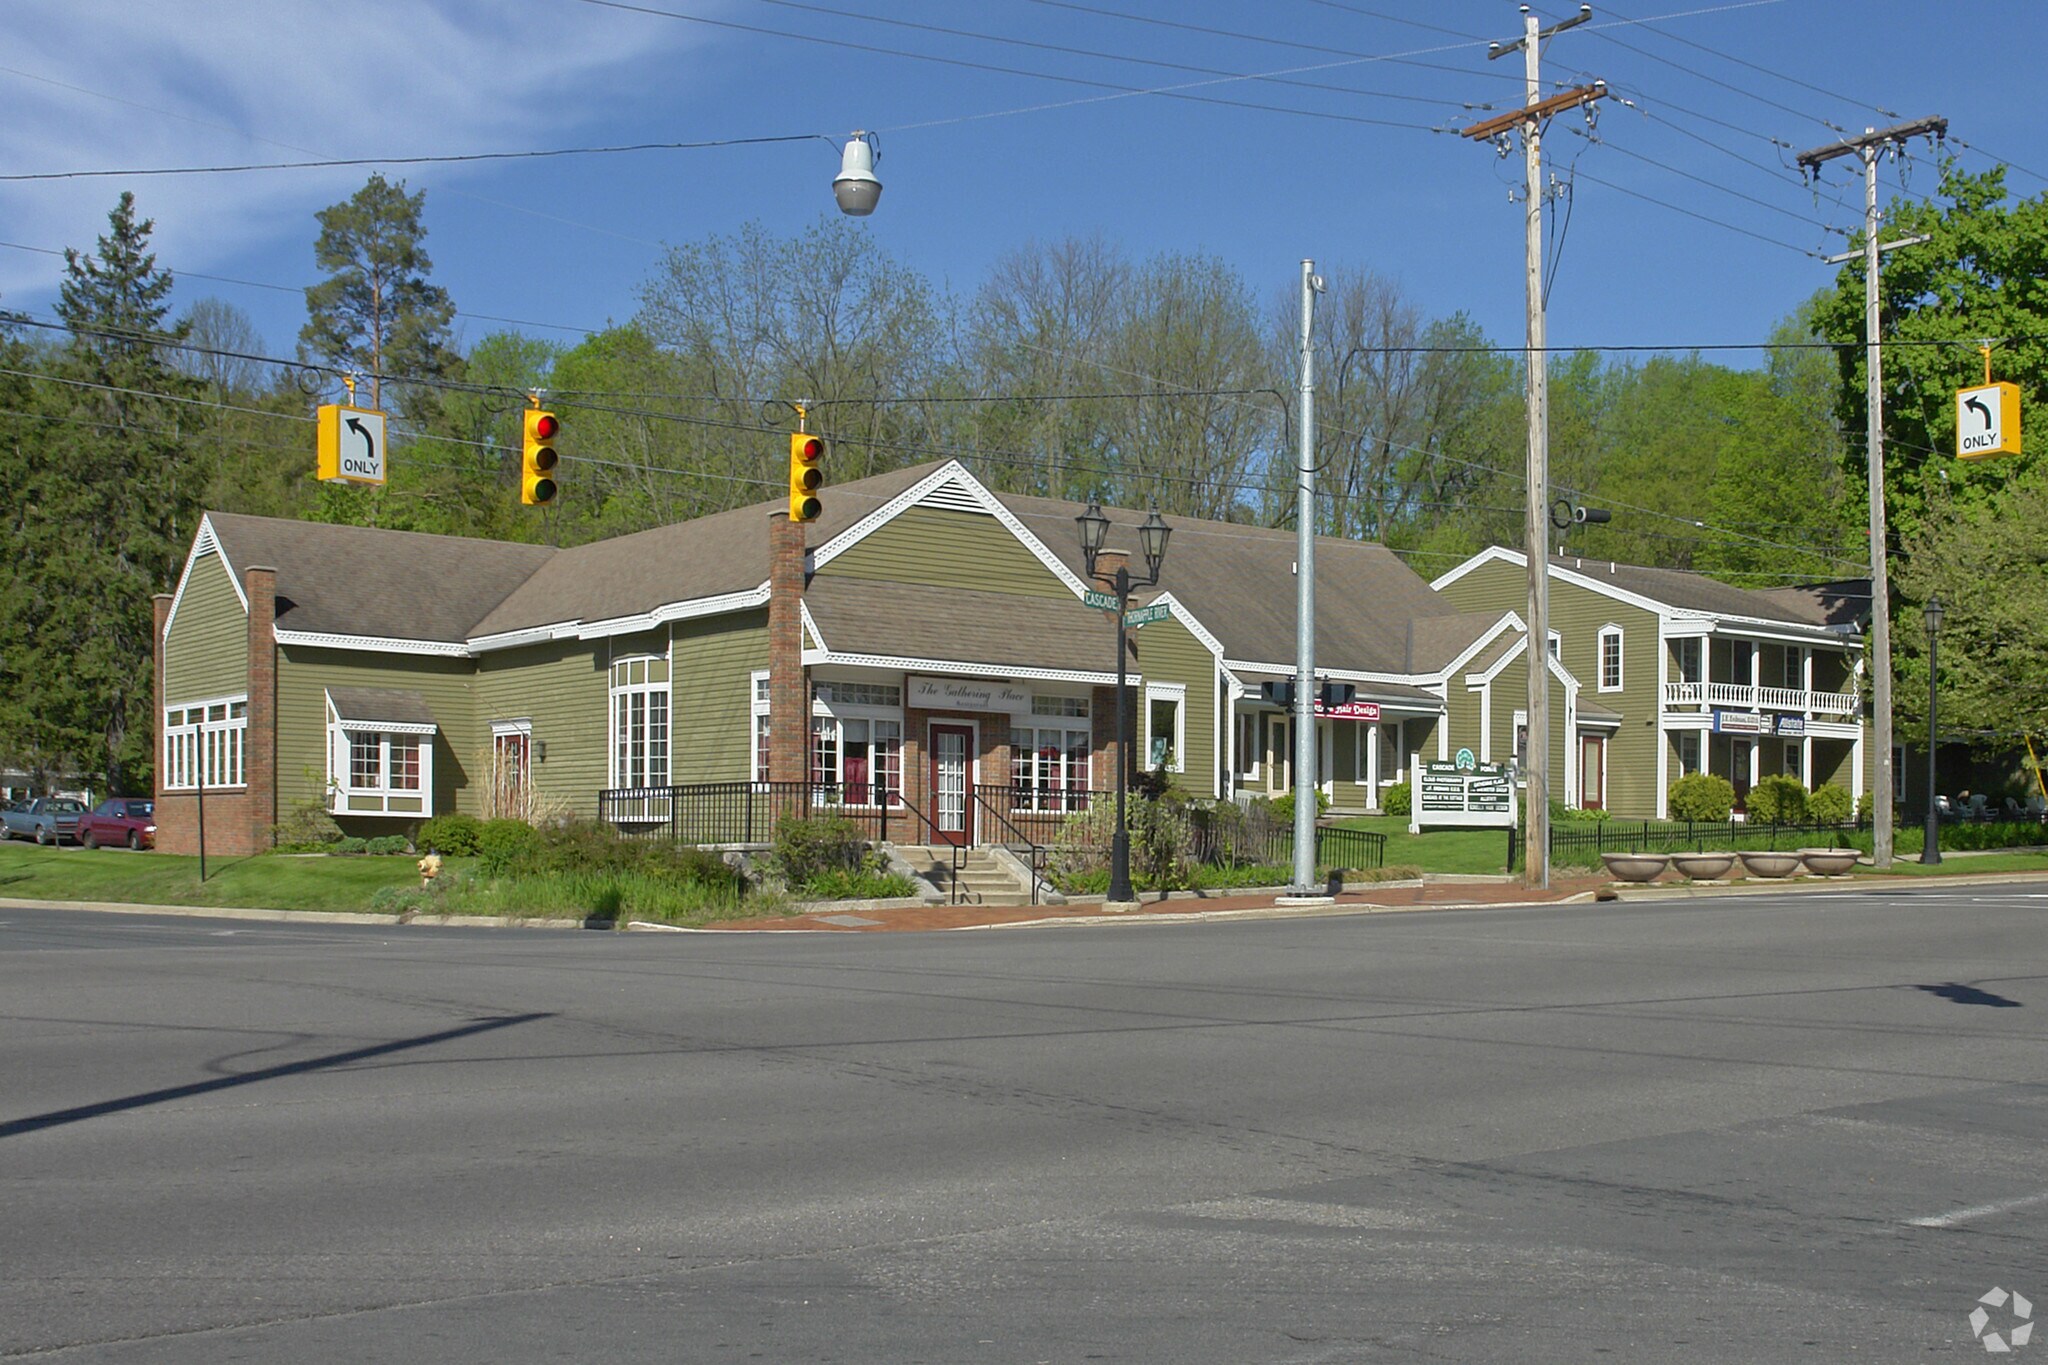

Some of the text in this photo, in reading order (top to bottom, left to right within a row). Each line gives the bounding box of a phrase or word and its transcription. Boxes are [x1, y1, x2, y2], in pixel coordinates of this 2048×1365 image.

[1963, 432, 1997, 450] ONLY
[344, 458, 379, 475] ONLY
[1085, 592, 1118, 610] CASCADE
[918, 682, 1024, 703] The Gathering Place
[1779, 717, 1803, 730] Allstate
